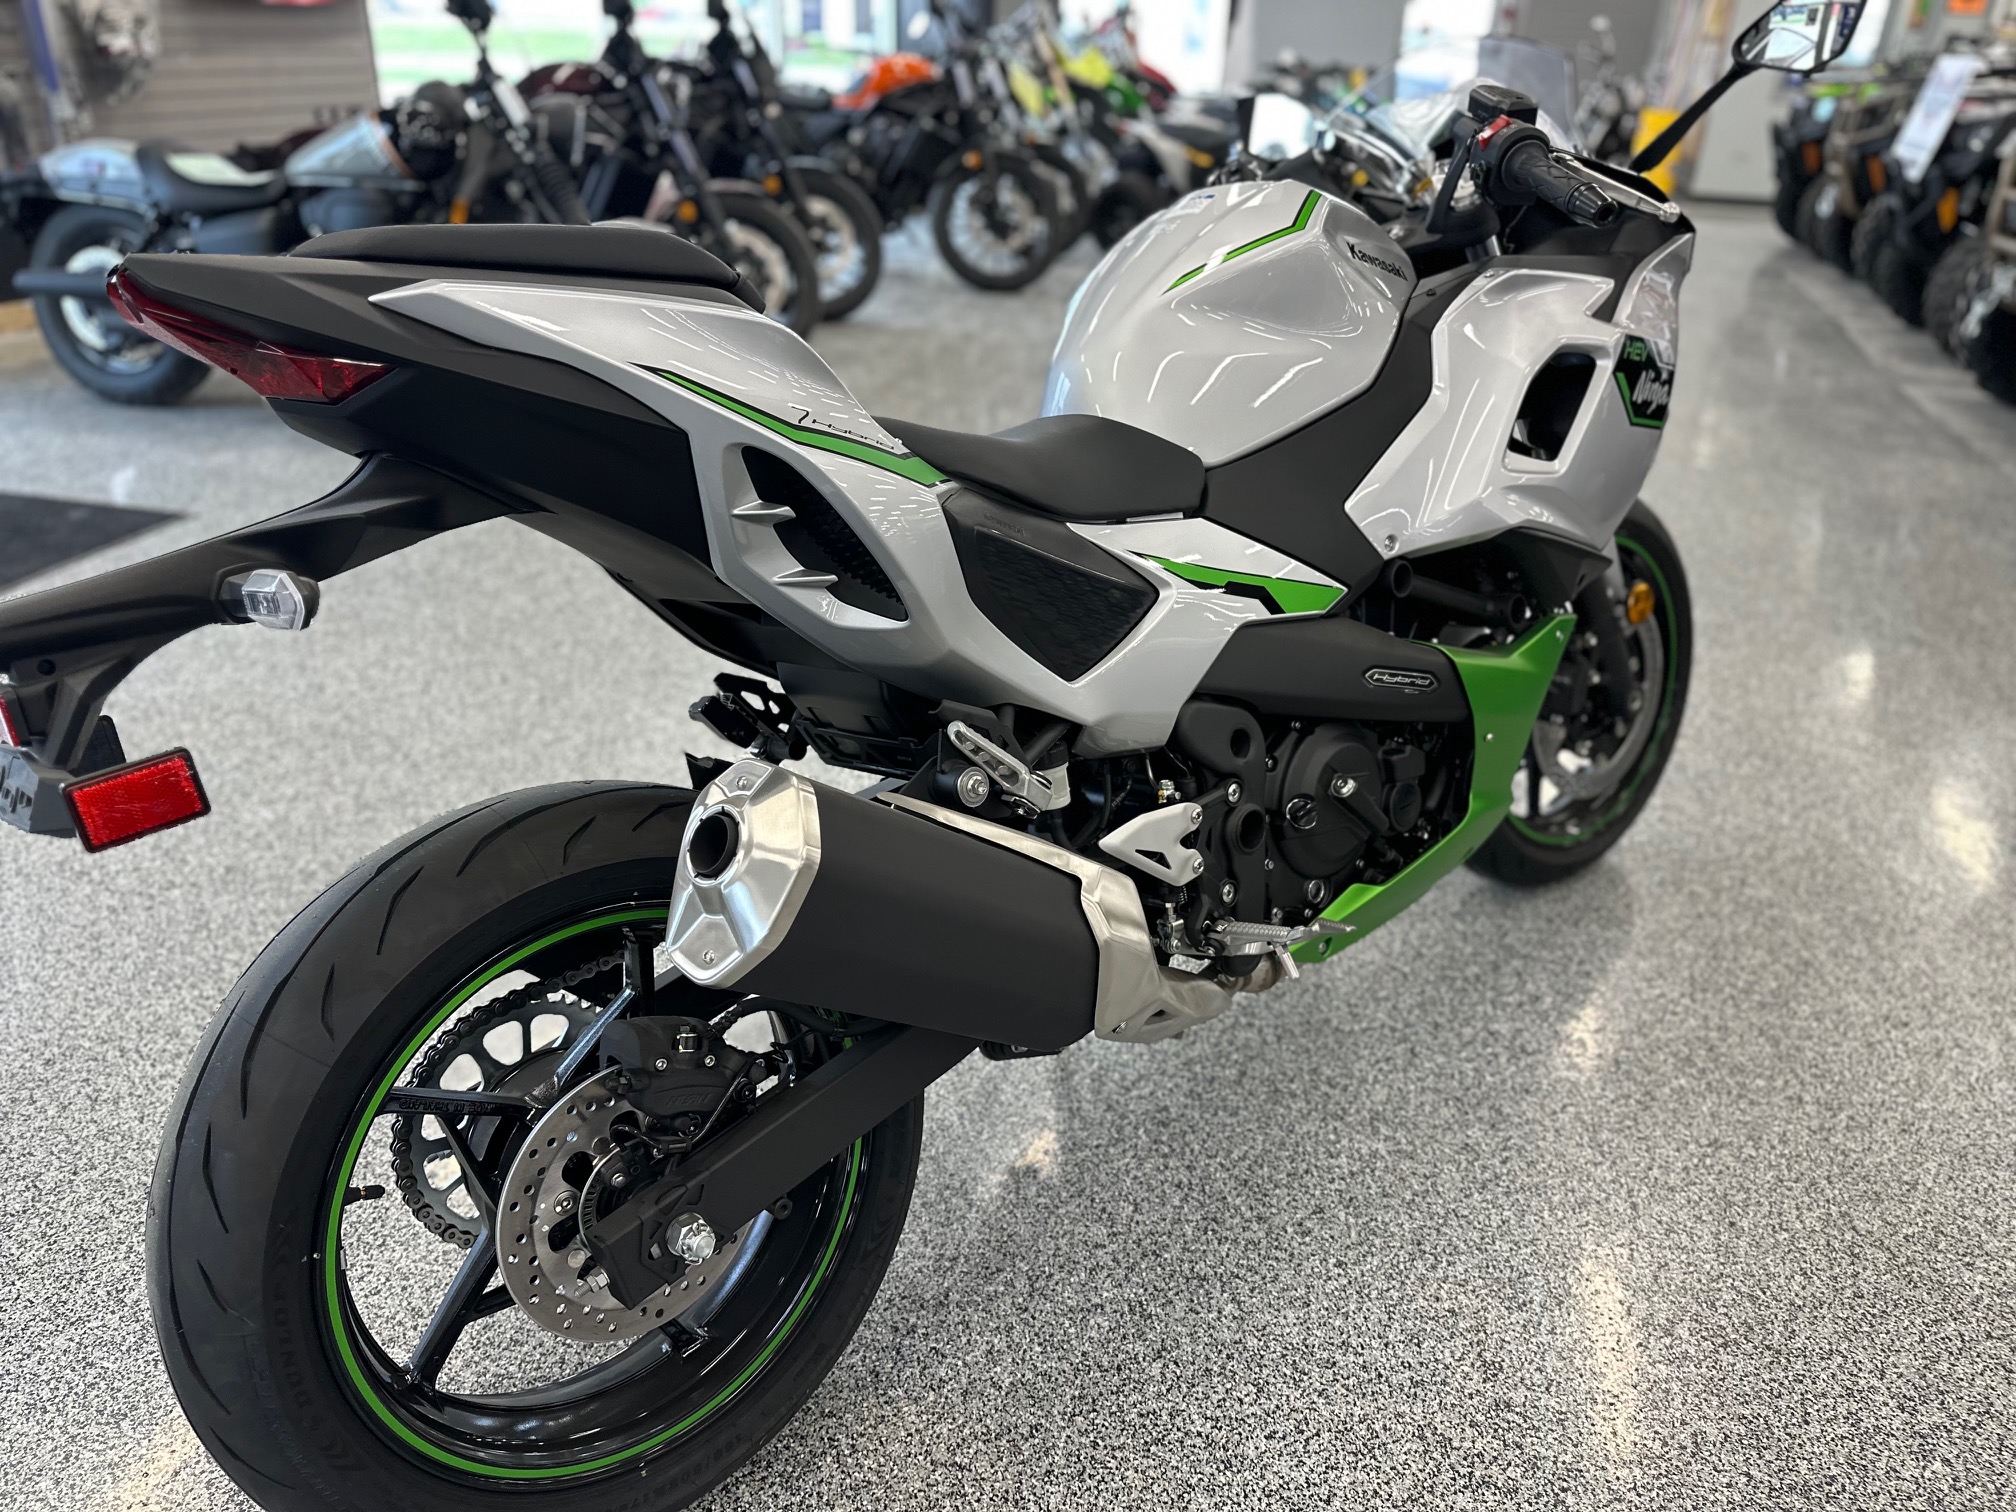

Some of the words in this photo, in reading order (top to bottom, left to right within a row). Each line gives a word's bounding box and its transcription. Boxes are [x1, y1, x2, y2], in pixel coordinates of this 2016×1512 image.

[1346, 241, 1409, 282] Kawasaki
[1623, 340, 1649, 362] HEV
[1632, 369, 1669, 416] Ninja
[811, 418, 894, 449] Hybrid
[1373, 673, 1431, 685] Hybrid
[398, 1098, 449, 1112] THAILAND
